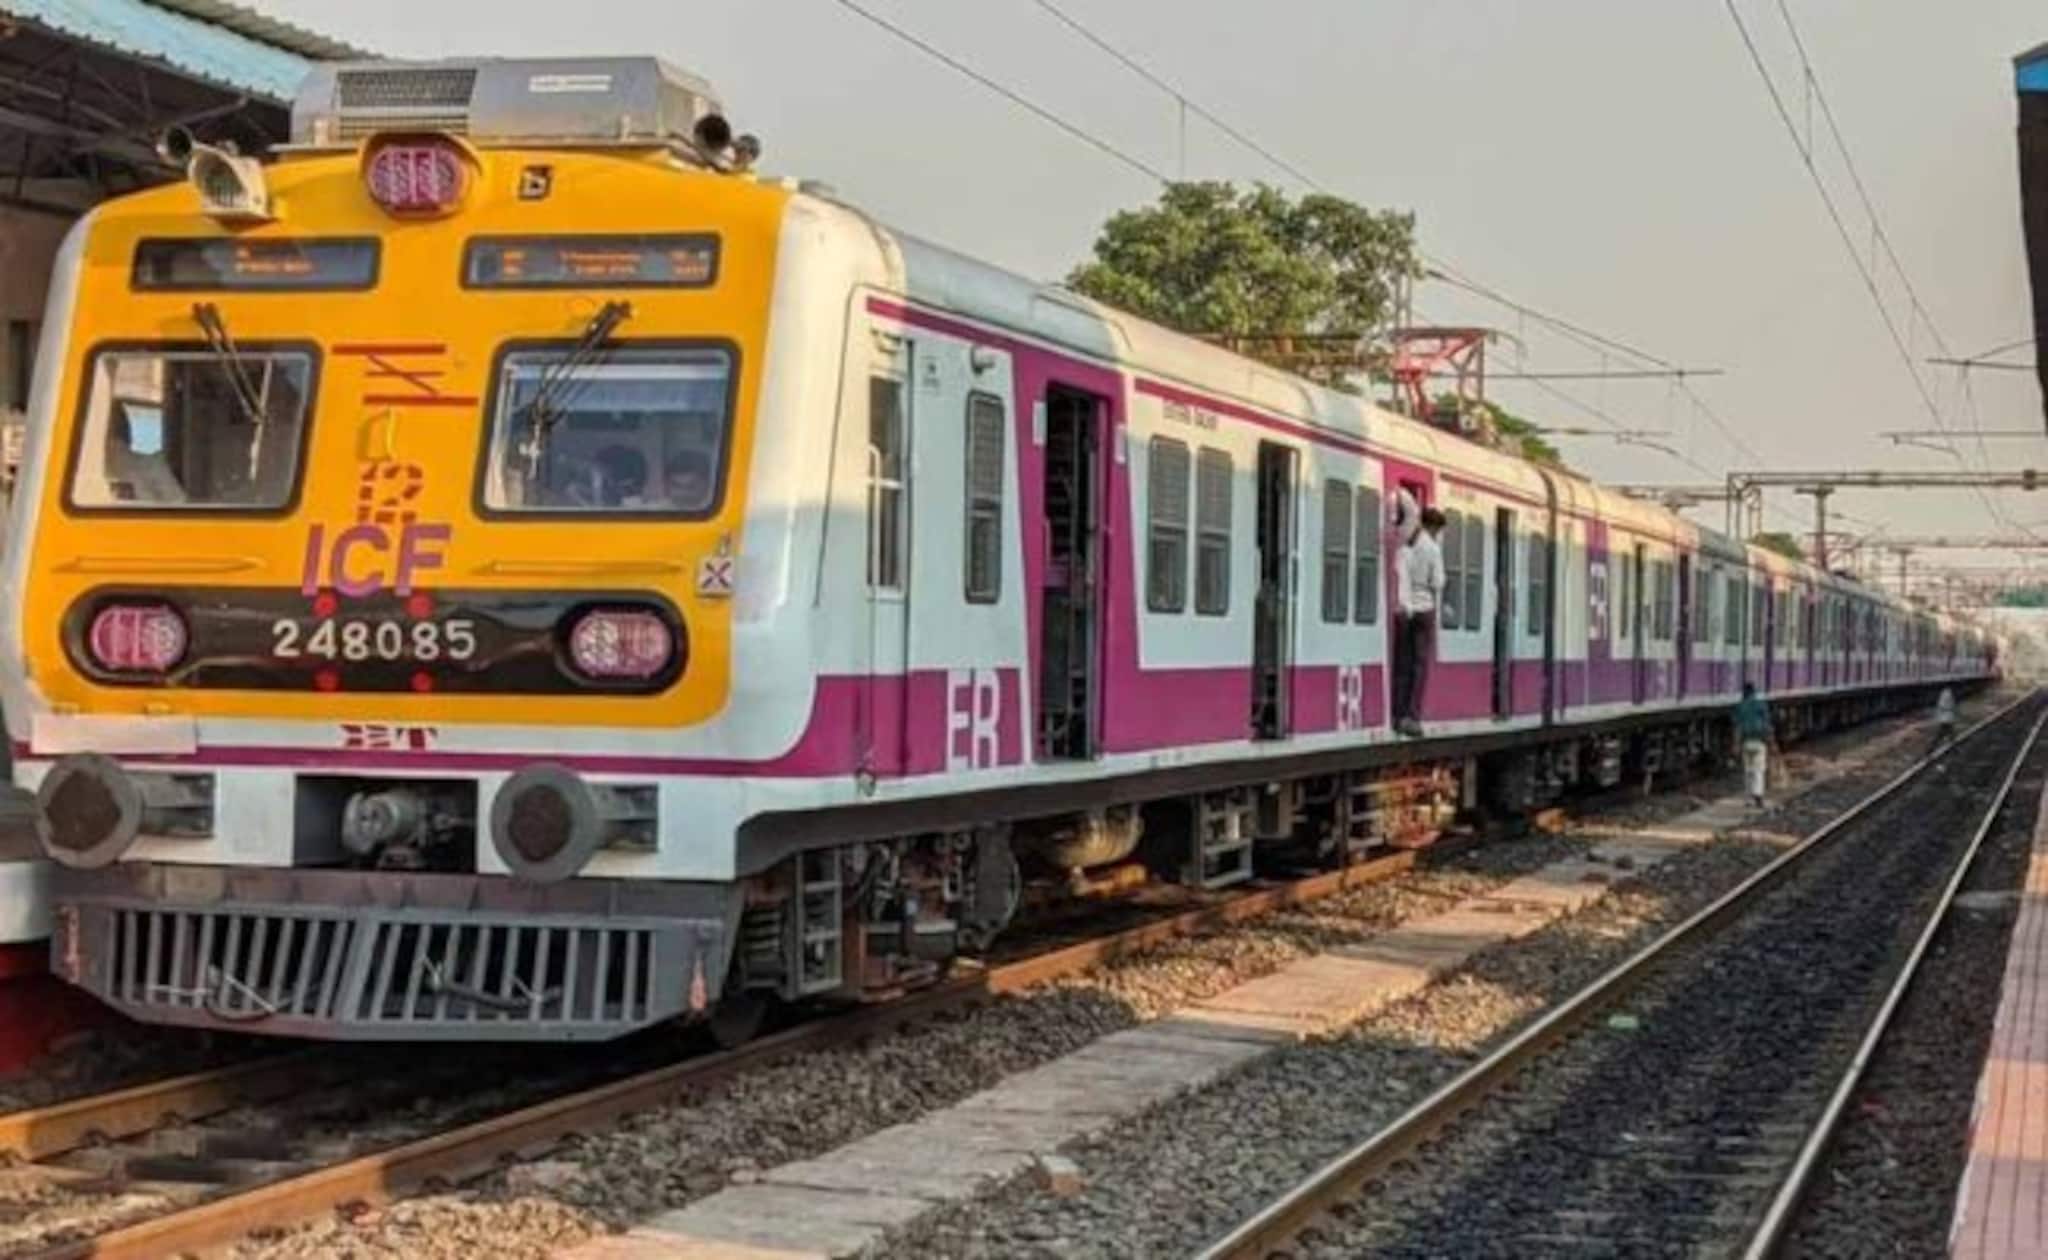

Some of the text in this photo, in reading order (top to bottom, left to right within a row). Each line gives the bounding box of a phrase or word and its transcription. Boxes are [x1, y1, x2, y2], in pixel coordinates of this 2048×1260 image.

[301, 522, 452, 598] ICF
[271, 618, 478, 661] 248085
[947, 668, 1000, 770] ER
[1338, 665, 1362, 731] ER
